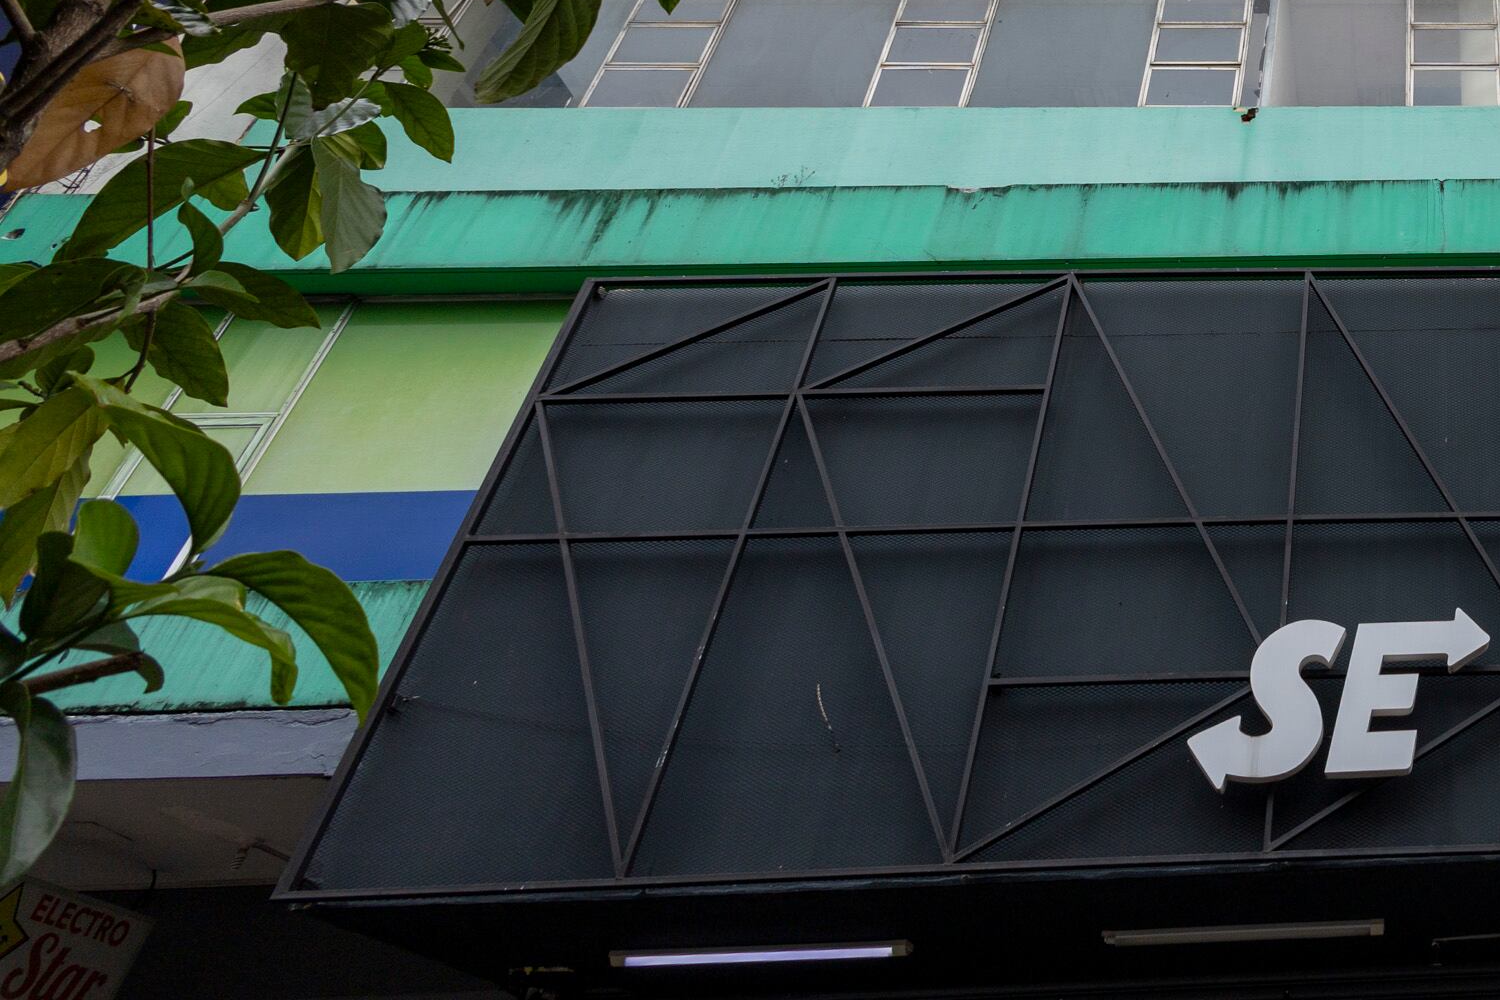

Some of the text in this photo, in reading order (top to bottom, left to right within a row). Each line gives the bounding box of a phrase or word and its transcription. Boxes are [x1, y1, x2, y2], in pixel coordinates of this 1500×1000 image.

[1187, 607, 1491, 795] SE
[31, 894, 130, 946] ELECTRO
[1, 932, 108, 1000] Star
